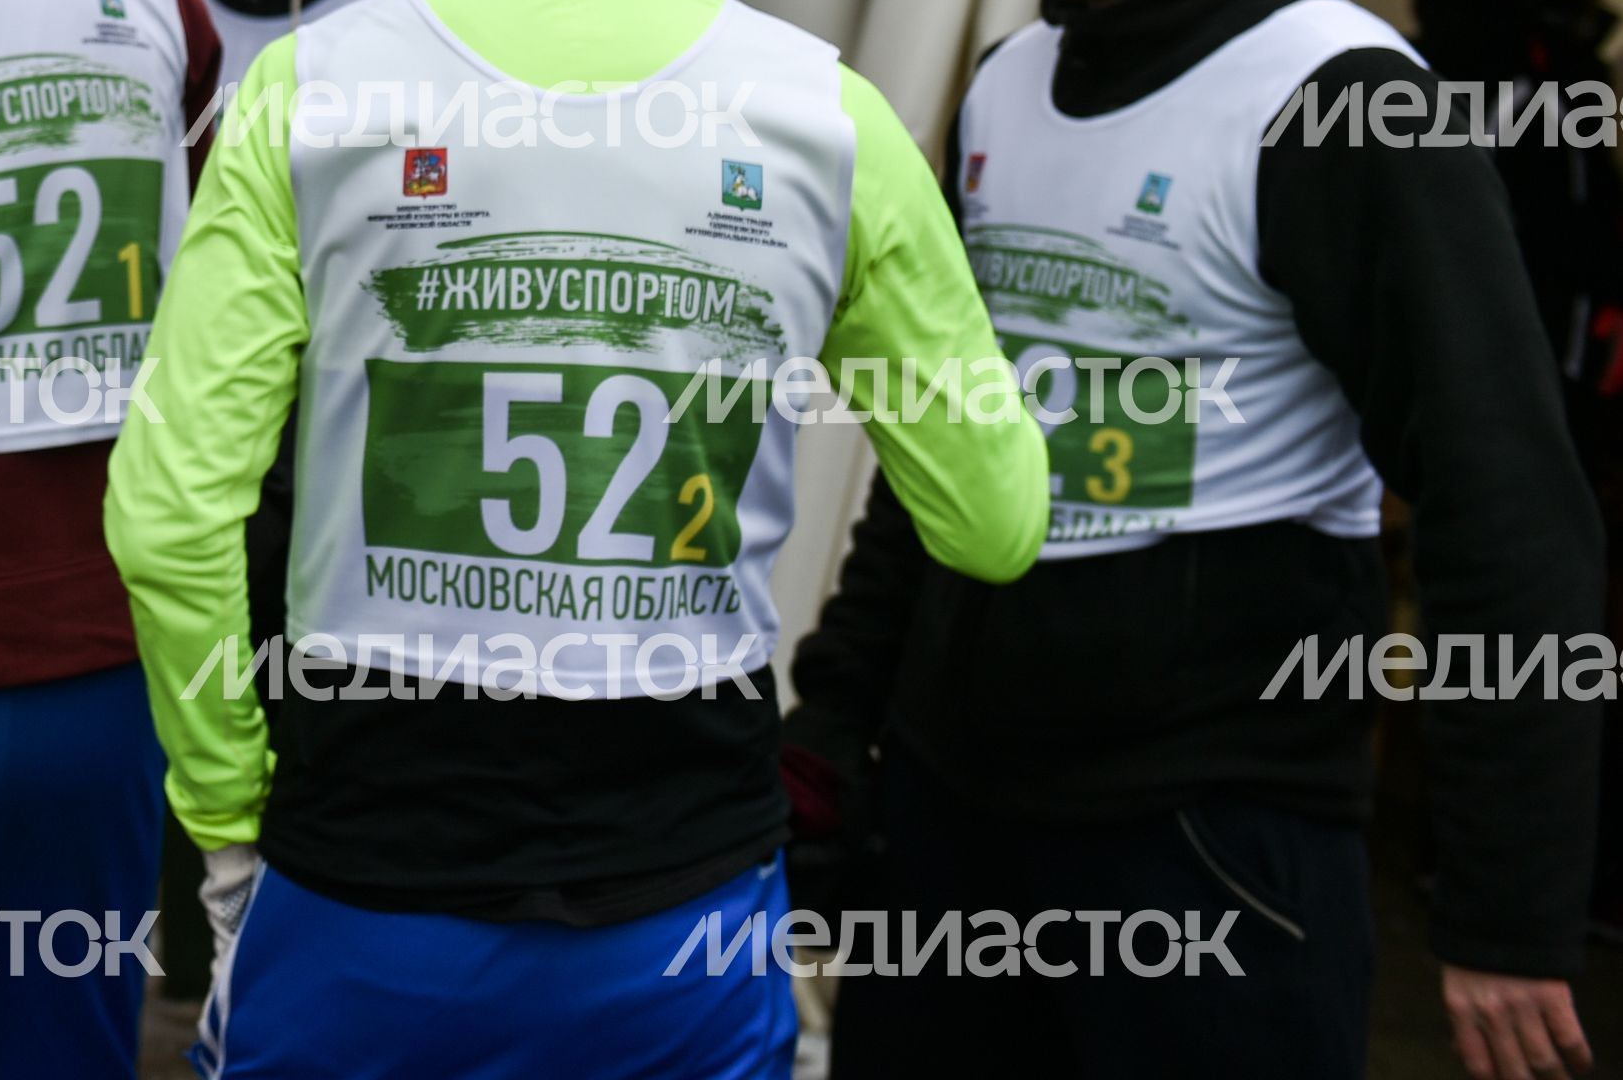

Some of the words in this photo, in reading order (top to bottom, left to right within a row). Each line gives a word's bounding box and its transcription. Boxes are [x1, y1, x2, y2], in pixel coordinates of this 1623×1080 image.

[118, 242, 144, 320] 1
[416, 267, 736, 325] #ЖИВУСПОРТОМ
[71, 328, 150, 374] ОБЛА
[479, 371, 671, 561] 52
[670, 474, 716, 563] 2
[1086, 428, 1134, 503] 3
[365, 554, 604, 621] МОСКОВСКАЯ
[612, 572, 741, 621] ОБЛАСТЬ
